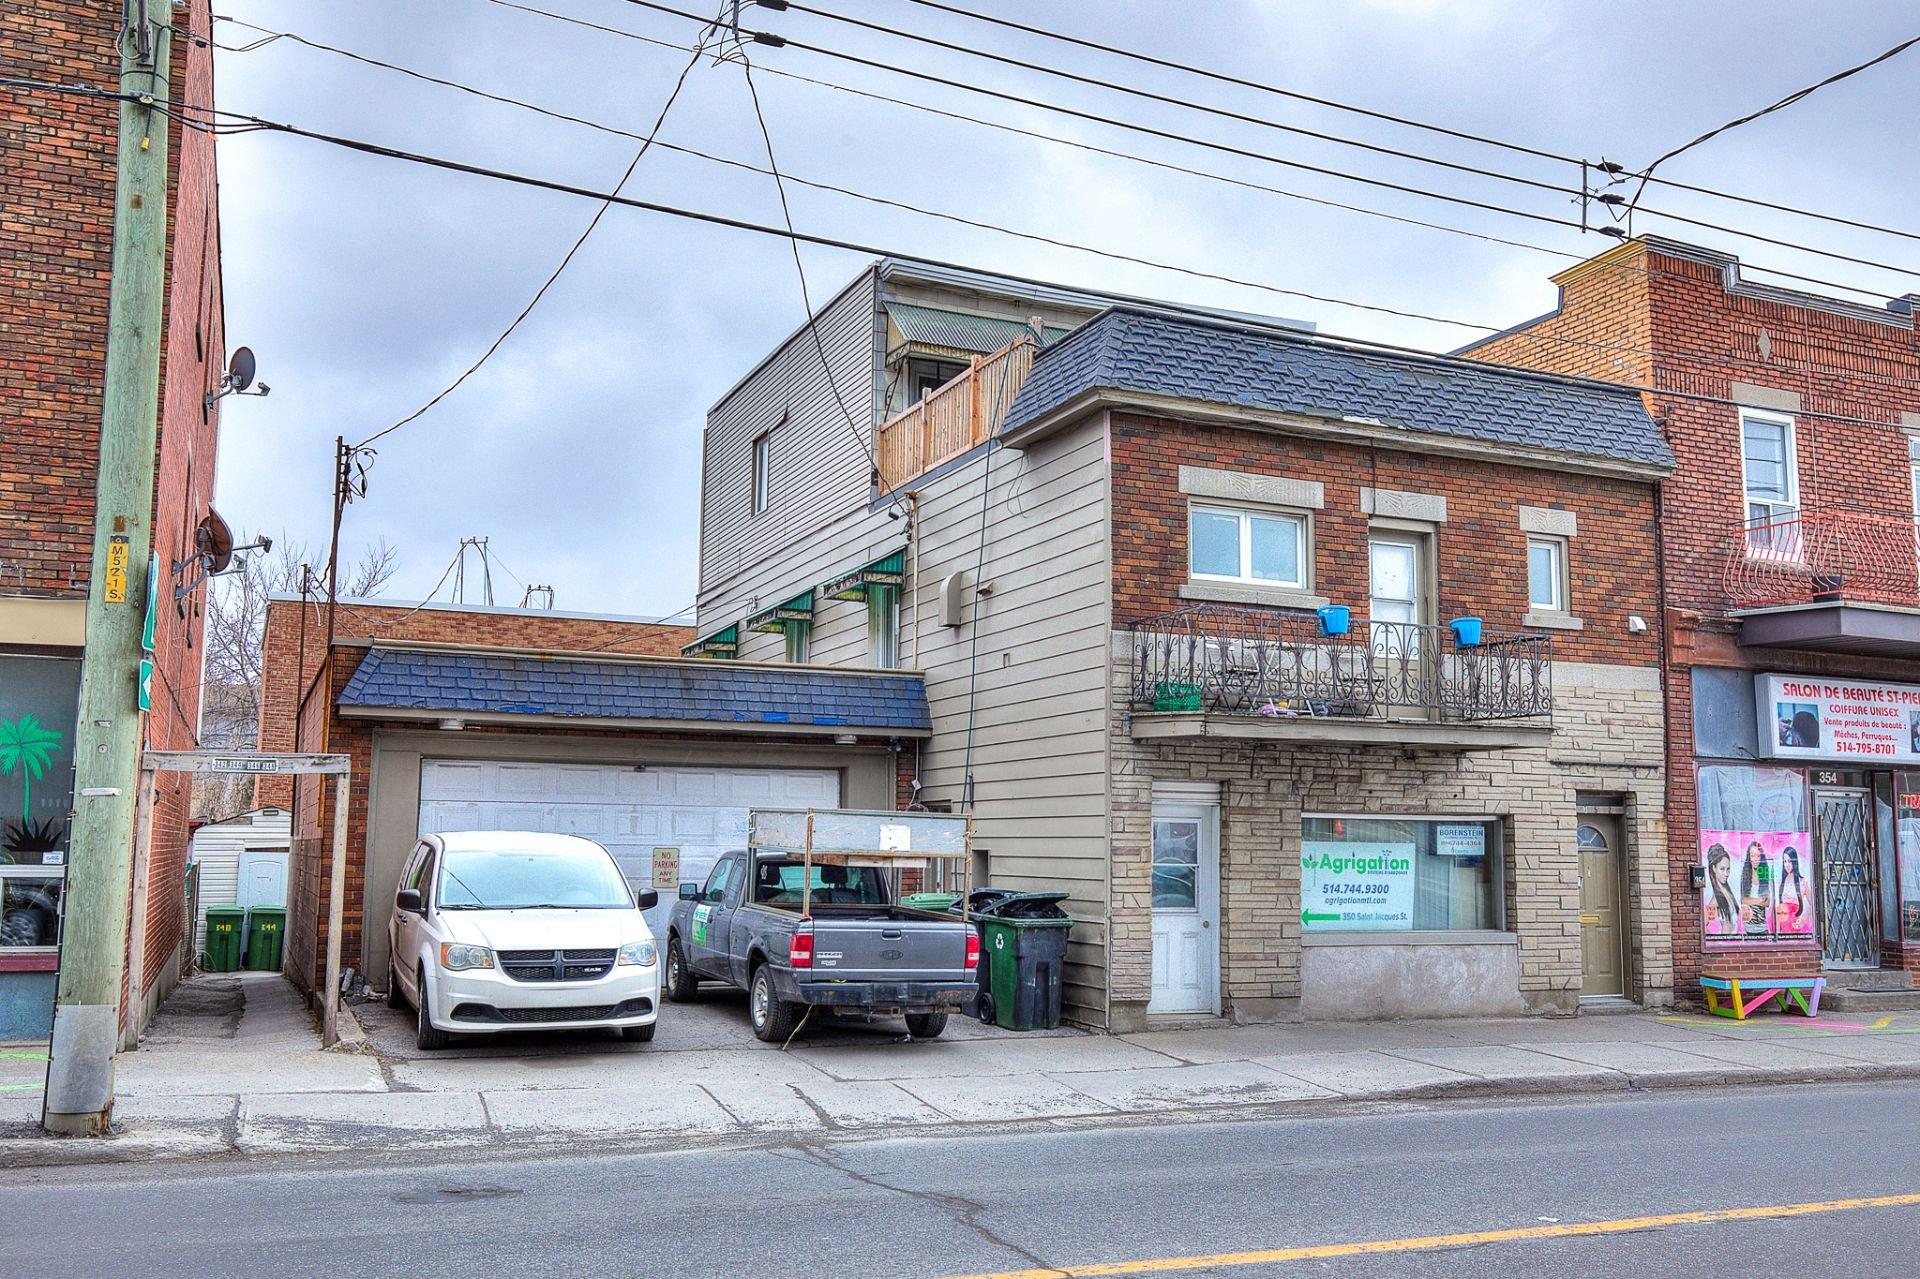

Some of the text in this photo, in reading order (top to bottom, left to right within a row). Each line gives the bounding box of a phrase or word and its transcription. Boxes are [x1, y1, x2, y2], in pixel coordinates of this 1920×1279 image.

[1783, 682, 1920, 704] SALON DE BEAUTÉ ST-PIE
[1829, 704, 1899, 717] COIFFURE UNISEX
[1823, 717, 1843, 726] Vente
[1844, 719, 1870, 728] produits
[1836, 742, 1896, 754] 514-795-8701
[1819, 772, 1837, 783] 354
[661, 851, 671, 859] NO
[655, 860, 678, 869] PARKING
[1320, 851, 1409, 874] Agrigation
[1322, 883, 1390, 894] 514.744.9300
[1324, 896, 1387, 906] agrigationmtl.com
[1342, 912, 1356, 920] 350
